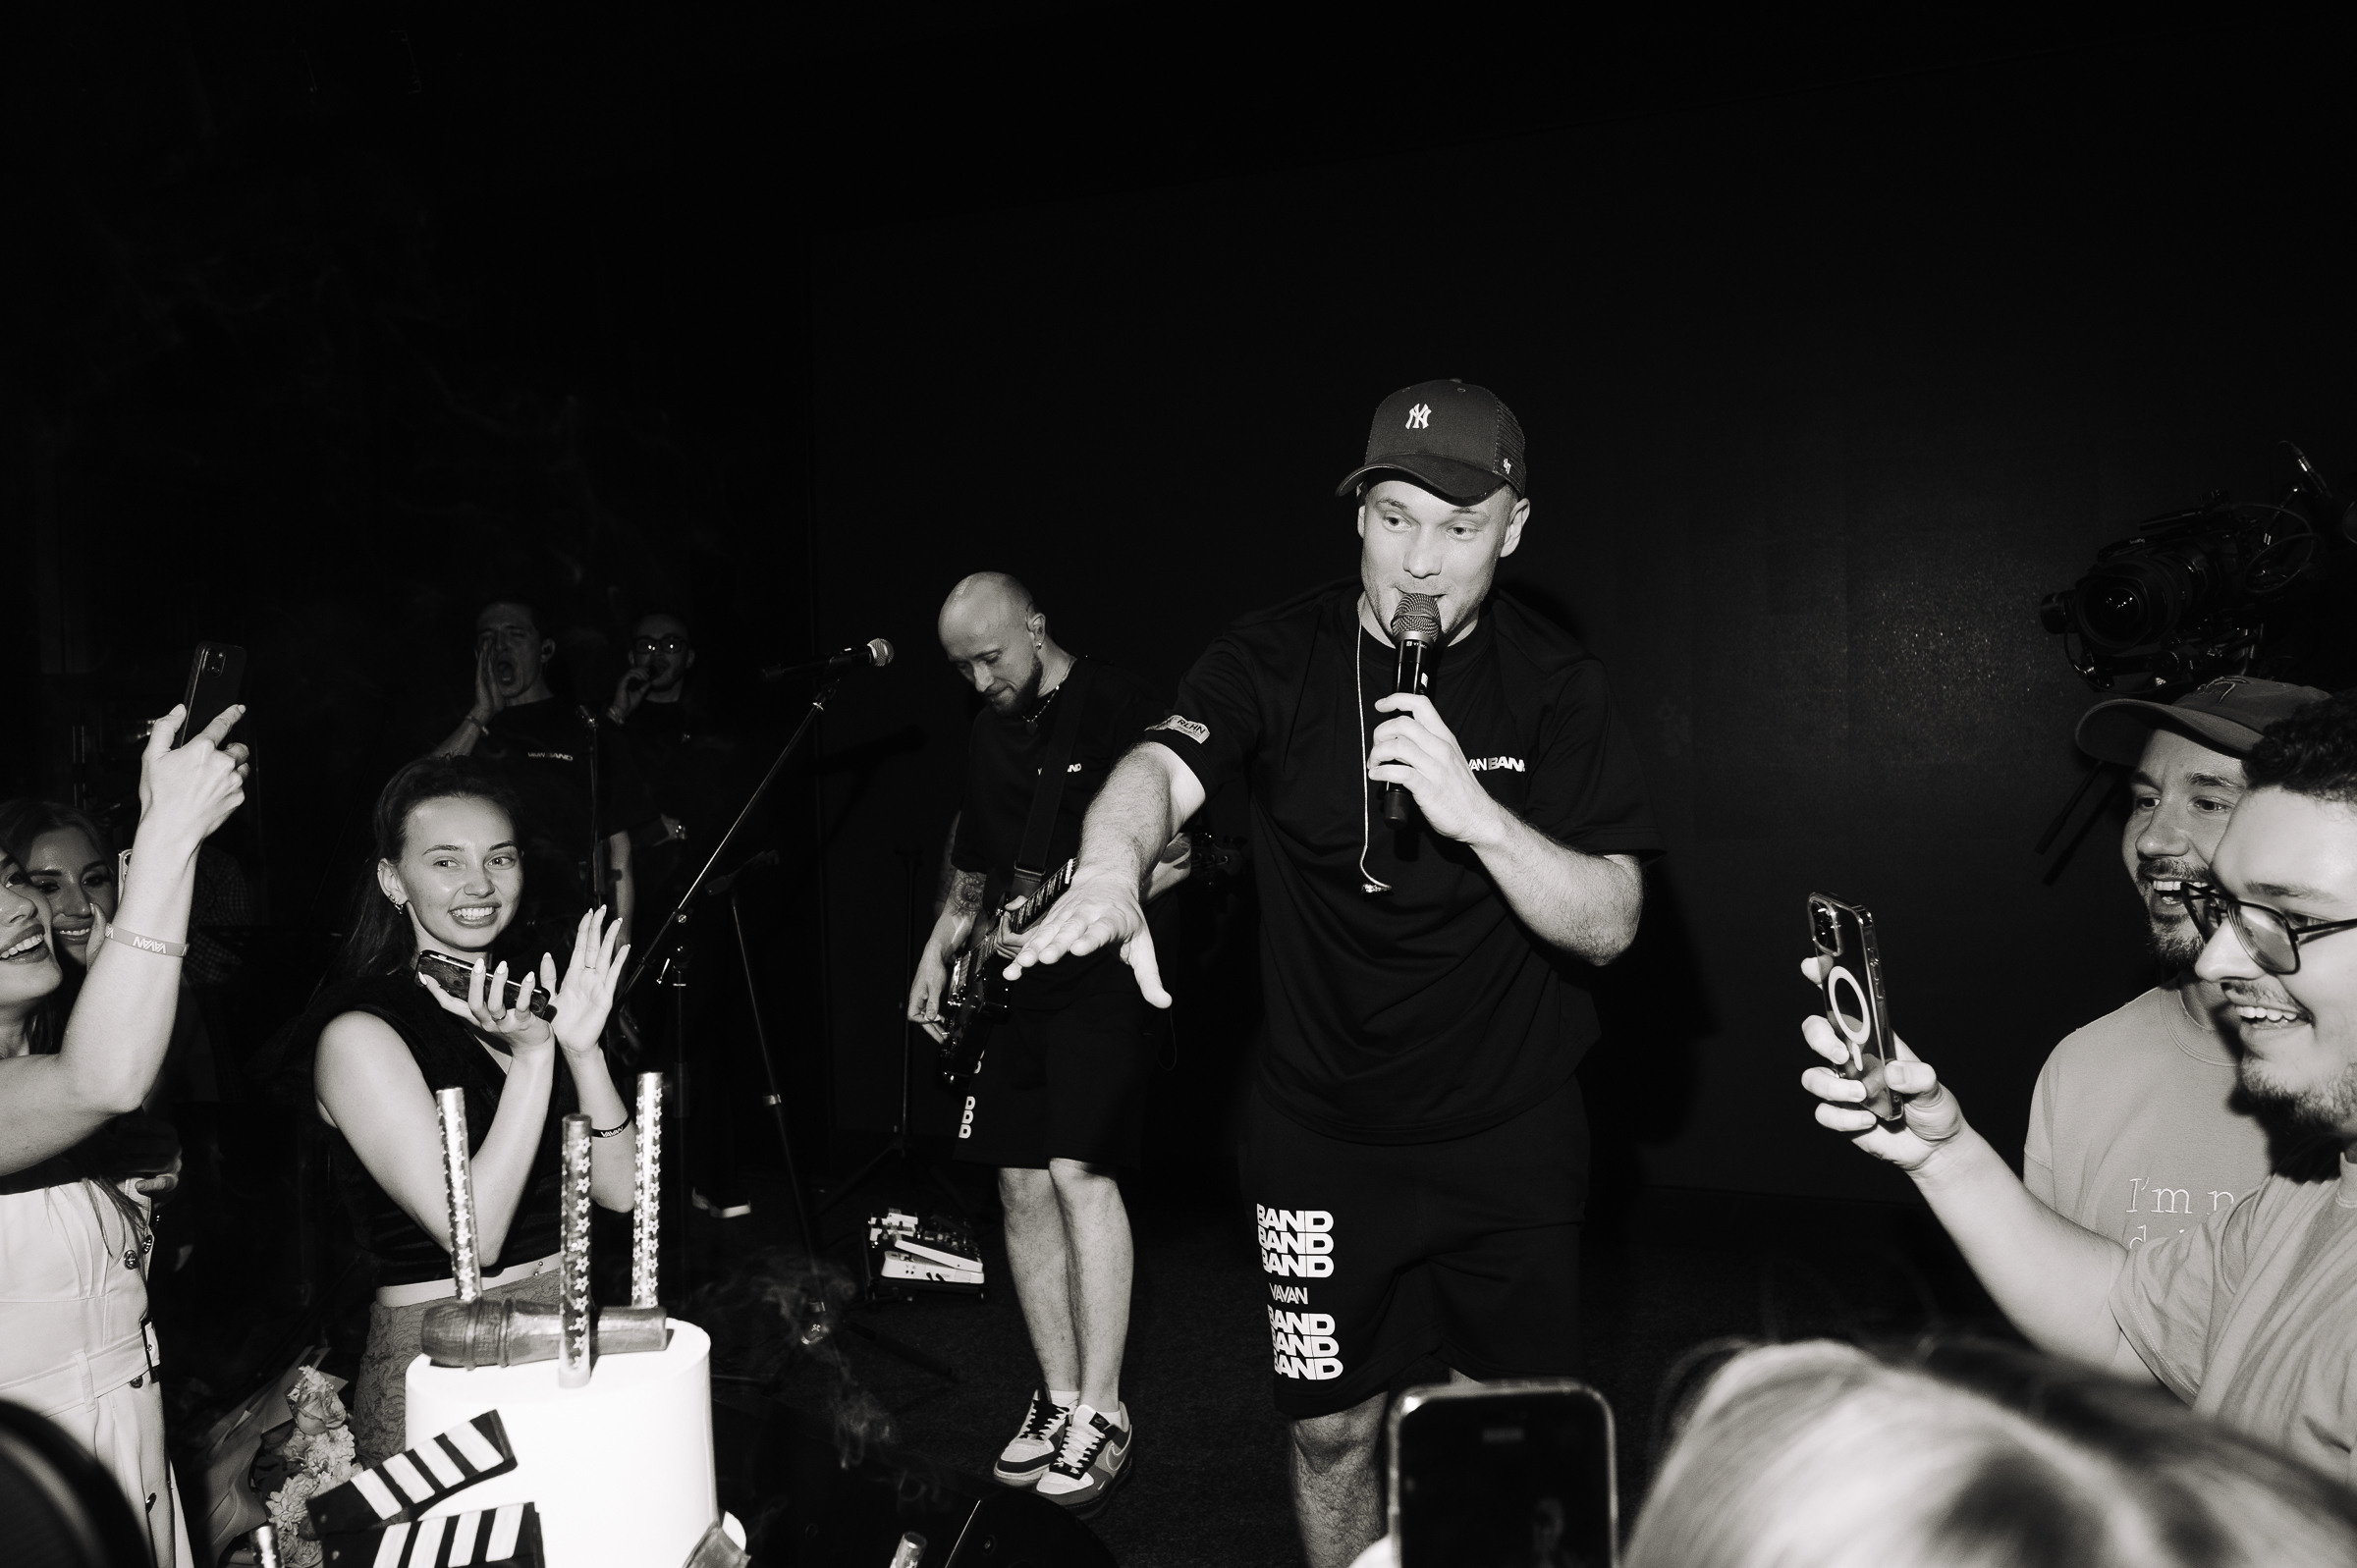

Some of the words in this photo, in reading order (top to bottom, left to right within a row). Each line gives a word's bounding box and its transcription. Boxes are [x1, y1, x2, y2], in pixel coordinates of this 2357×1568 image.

[1404, 403, 1433, 430] NY
[2125, 1176, 2193, 1215] I'm
[1256, 1203, 1334, 1233] BAND
[1258, 1224, 1334, 1255] BAND
[1261, 1247, 1335, 1278] BAND
[1268, 1281, 1309, 1305] VAVAN
[1267, 1304, 1336, 1336] BAND
